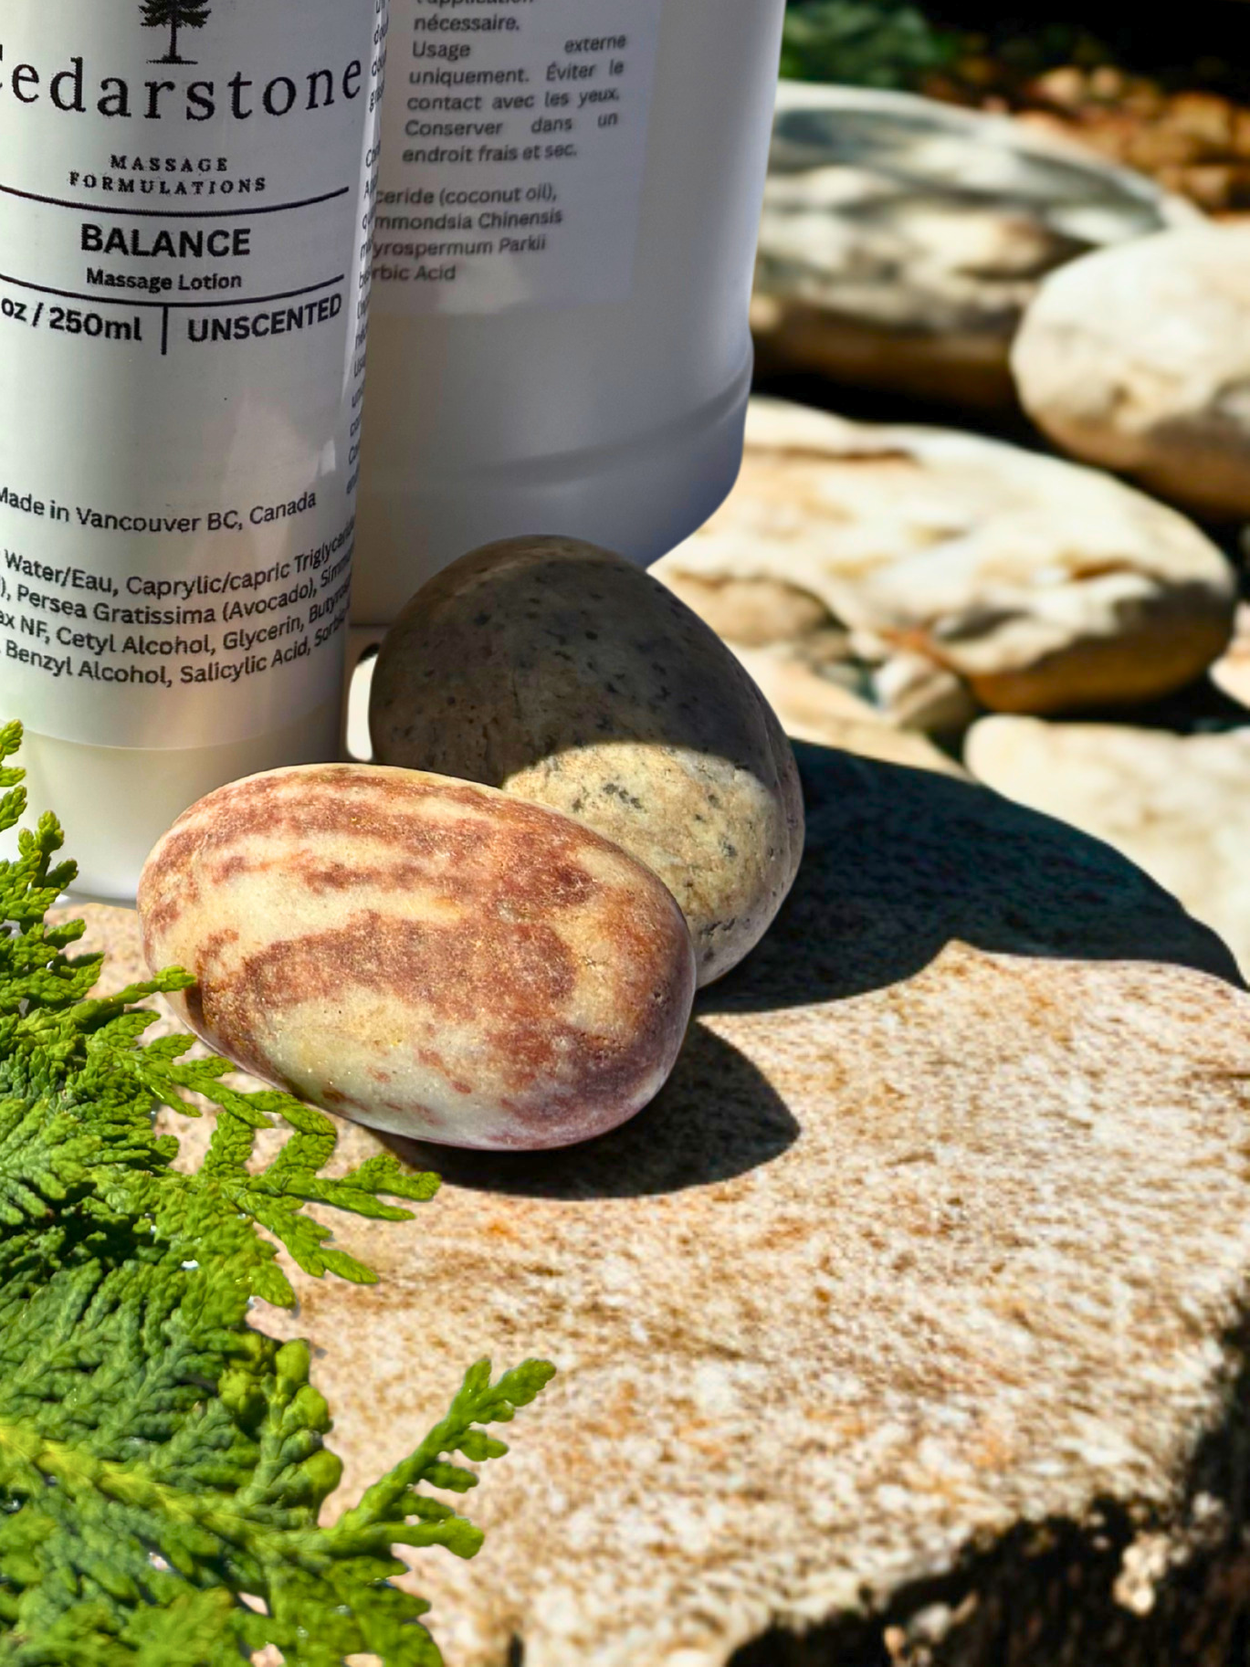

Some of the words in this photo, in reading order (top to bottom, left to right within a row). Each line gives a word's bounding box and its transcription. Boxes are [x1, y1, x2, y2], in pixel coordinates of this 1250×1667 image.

[70, 172, 266, 195] FORMULATIONS
[110, 154, 228, 172] MASSAGE
[440, 187, 522, 206] (coconut
[526, 183, 557, 202] oil),
[80, 224, 251, 258] BALANCE
[86, 267, 172, 293] Massage
[178, 271, 242, 291] Lotion
[2, 298, 27, 321] oz
[50, 307, 142, 341] 250ml
[189, 293, 342, 343] UNSCENTED
[50, 500, 69, 522] in
[76, 507, 200, 533] Vancouver
[208, 511, 242, 531] BC,
[250, 491, 316, 525] Canada
[2, 549, 118, 597] Water/Eau,
[126, 562, 290, 599] Caprylic/capric
[18, 584, 86, 619] Persea
[93, 601, 216, 625] Gratissima
[222, 581, 318, 622] (Avocado),
[21, 615, 50, 644] NF,
[56, 628, 116, 656] Cetyl
[122, 635, 216, 656] Alcohol,
[222, 614, 306, 652] Glycerin,
[6, 641, 72, 676] Benzyl
[78, 662, 172, 687] Alcohol,
[180, 654, 266, 685] Salicylic
[271, 637, 311, 667] Acid,
